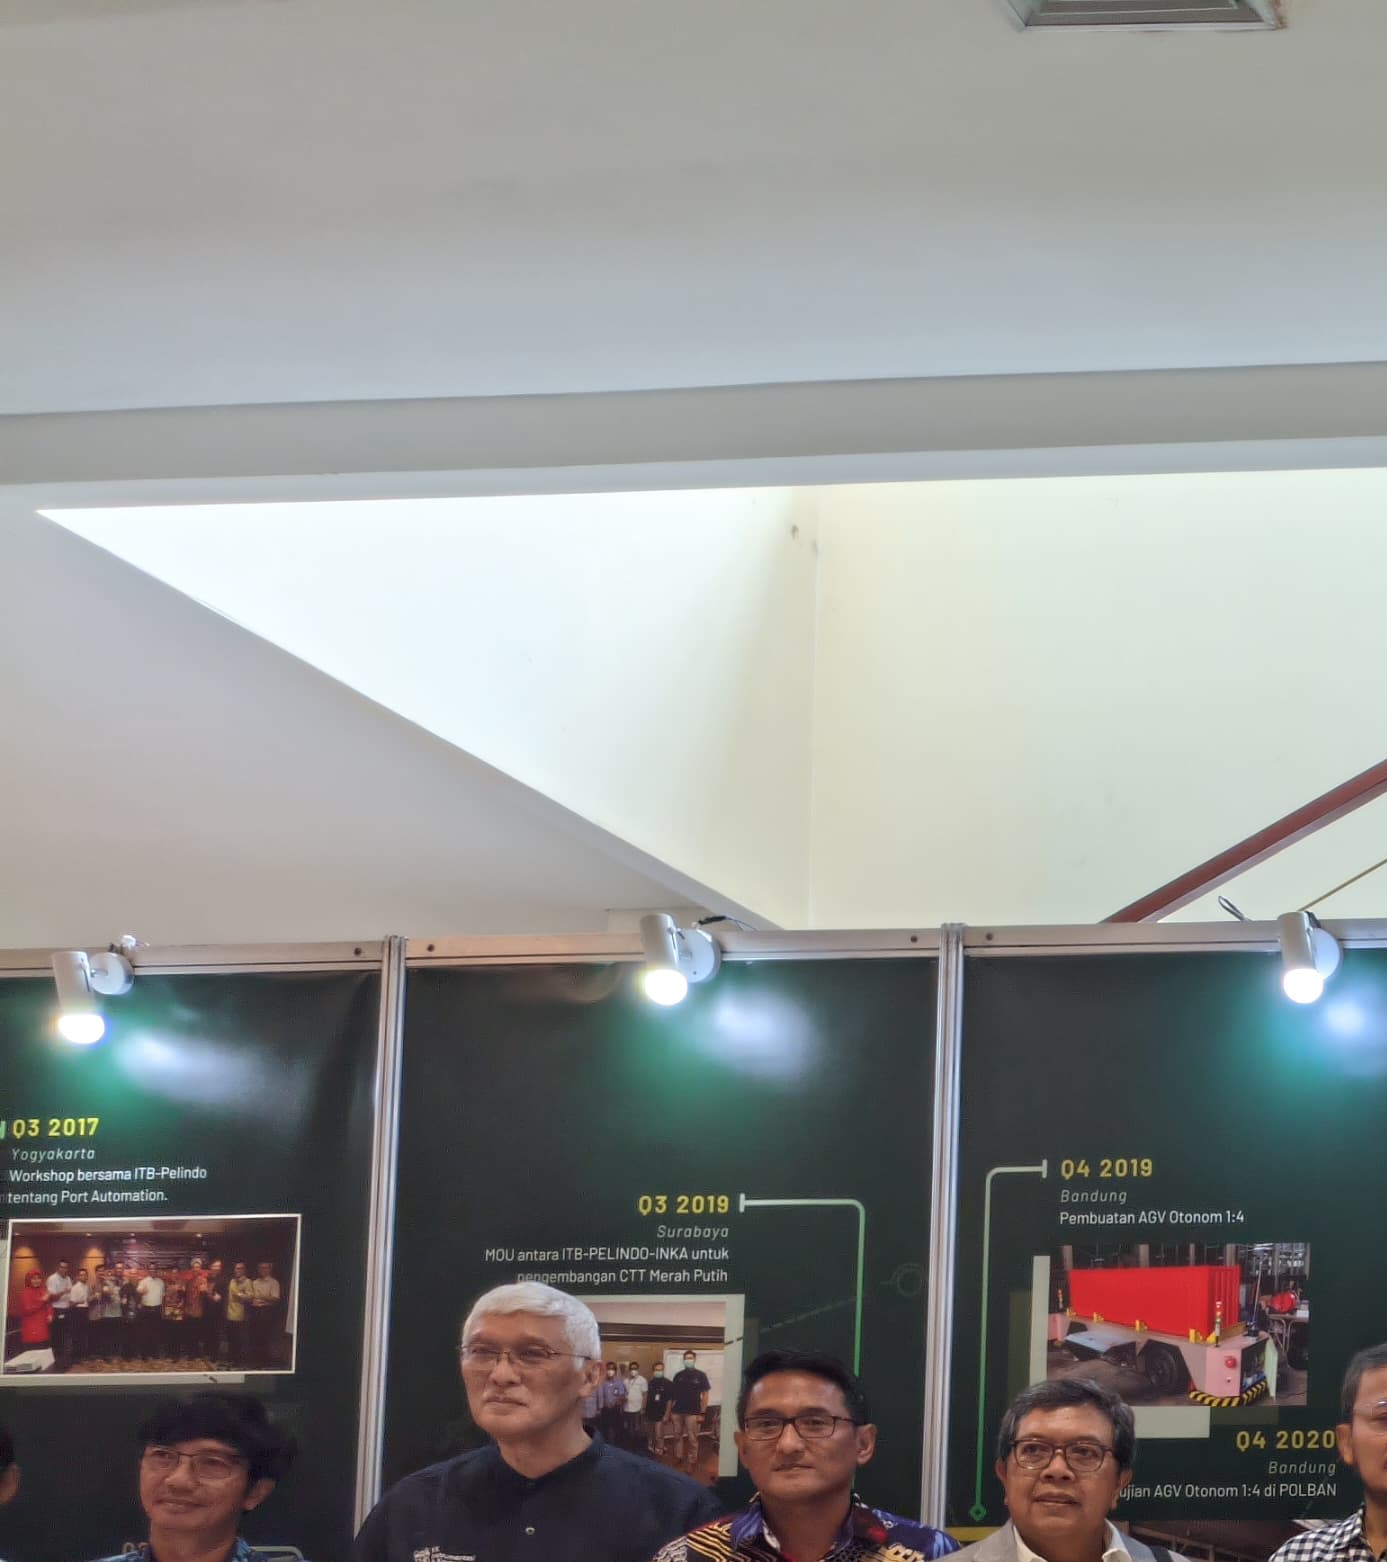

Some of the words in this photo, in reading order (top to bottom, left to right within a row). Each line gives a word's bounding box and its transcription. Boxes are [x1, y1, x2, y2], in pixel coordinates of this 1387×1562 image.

[13, 1119, 40, 1138] Q3
[48, 1118, 99, 1136] 2017
[11, 1148, 95, 1163] Yogyakarta
[9, 1169, 75, 1183] Workshop
[77, 1169, 131, 1181] bersama
[134, 1166, 207, 1180] ITB-Pelindo
[1060, 1159, 1090, 1180] Q4
[1099, 1158, 1153, 1177] 2019
[8, 1192, 58, 1205] tentang
[61, 1191, 88, 1203] Port
[91, 1189, 168, 1202] Automation.
[638, 1195, 667, 1215] Q3
[676, 1195, 729, 1214] 2019
[1060, 1189, 1127, 1205] Bandung
[1060, 1211, 1135, 1225] Pembuatan
[1138, 1210, 1167, 1224] AGV
[1169, 1210, 1222, 1224] Otonom
[1226, 1210, 1244, 1223] 1:4
[657, 1225, 729, 1240] Surabaya
[485, 1248, 514, 1262] MOU
[518, 1250, 559, 1262] antara
[562, 1247, 688, 1261] ITB-PELINDO-INKA
[692, 1248, 729, 1260] untuk
[518, 1270, 615, 1285] pengembangan
[620, 1269, 646, 1282] CTT
[650, 1269, 690, 1282] Merah
[694, 1269, 728, 1282] Putih
[1236, 1430, 1266, 1452] Q4
[1276, 1430, 1336, 1449] 2020
[1268, 1461, 1336, 1476] Bandung
[1119, 1485, 1150, 1500] ujian
[1153, 1484, 1182, 1498] AGV
[1185, 1484, 1238, 1497] Otonom
[1242, 1484, 1261, 1497] 1:4
[1264, 1483, 1277, 1497] di
[1279, 1483, 1337, 1497] POLBAN
